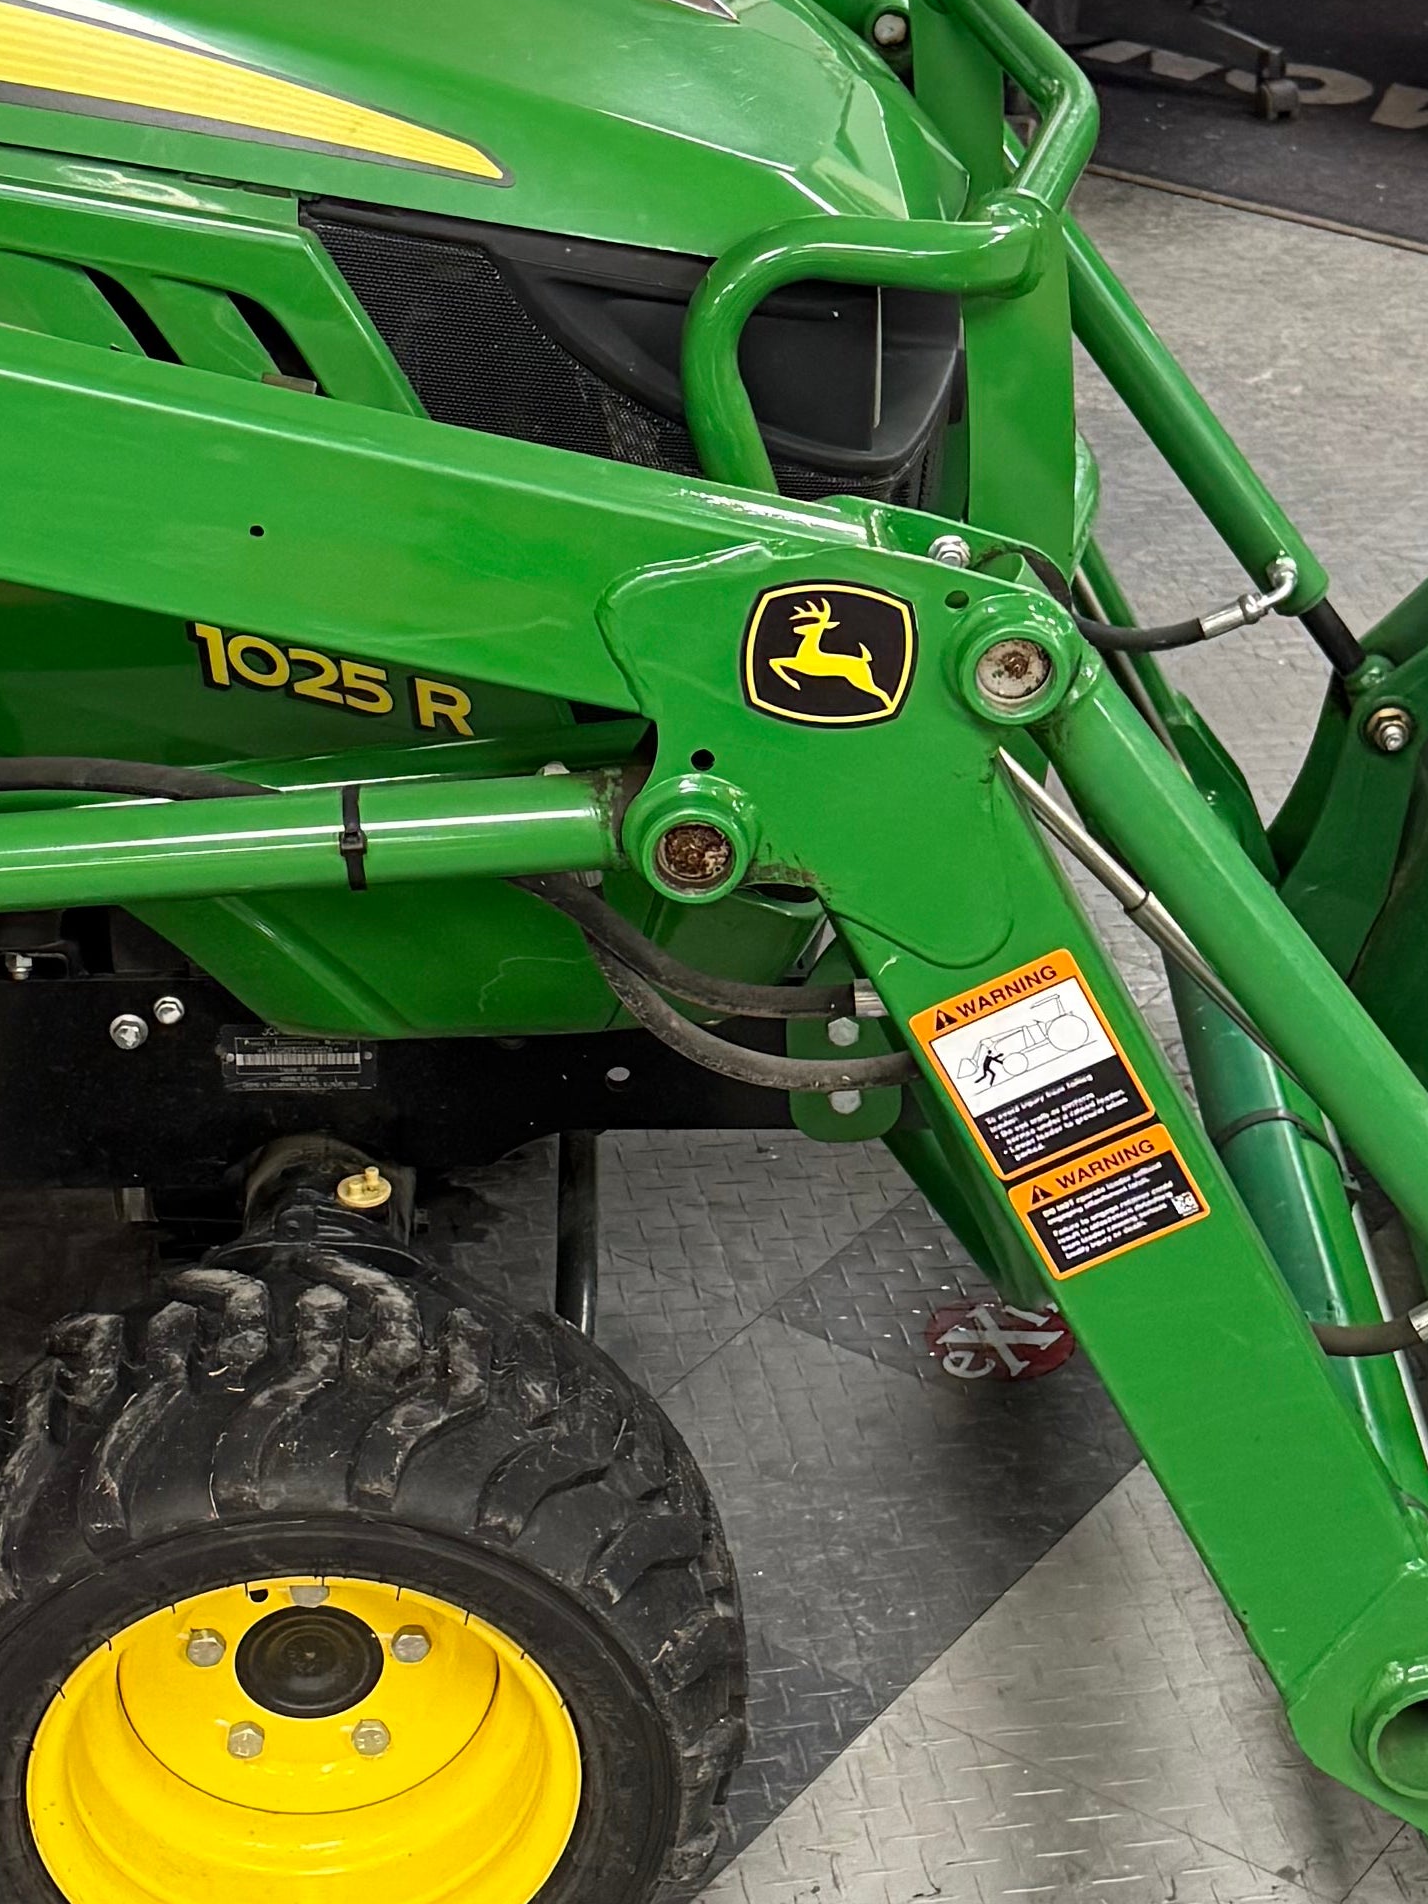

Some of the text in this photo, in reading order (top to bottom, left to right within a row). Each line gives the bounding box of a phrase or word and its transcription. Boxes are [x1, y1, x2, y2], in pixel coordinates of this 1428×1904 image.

[190, 619, 475, 736] 1025 R
[955, 965, 1057, 1018] WARNING
[1055, 1139, 1155, 1190] WARNING
